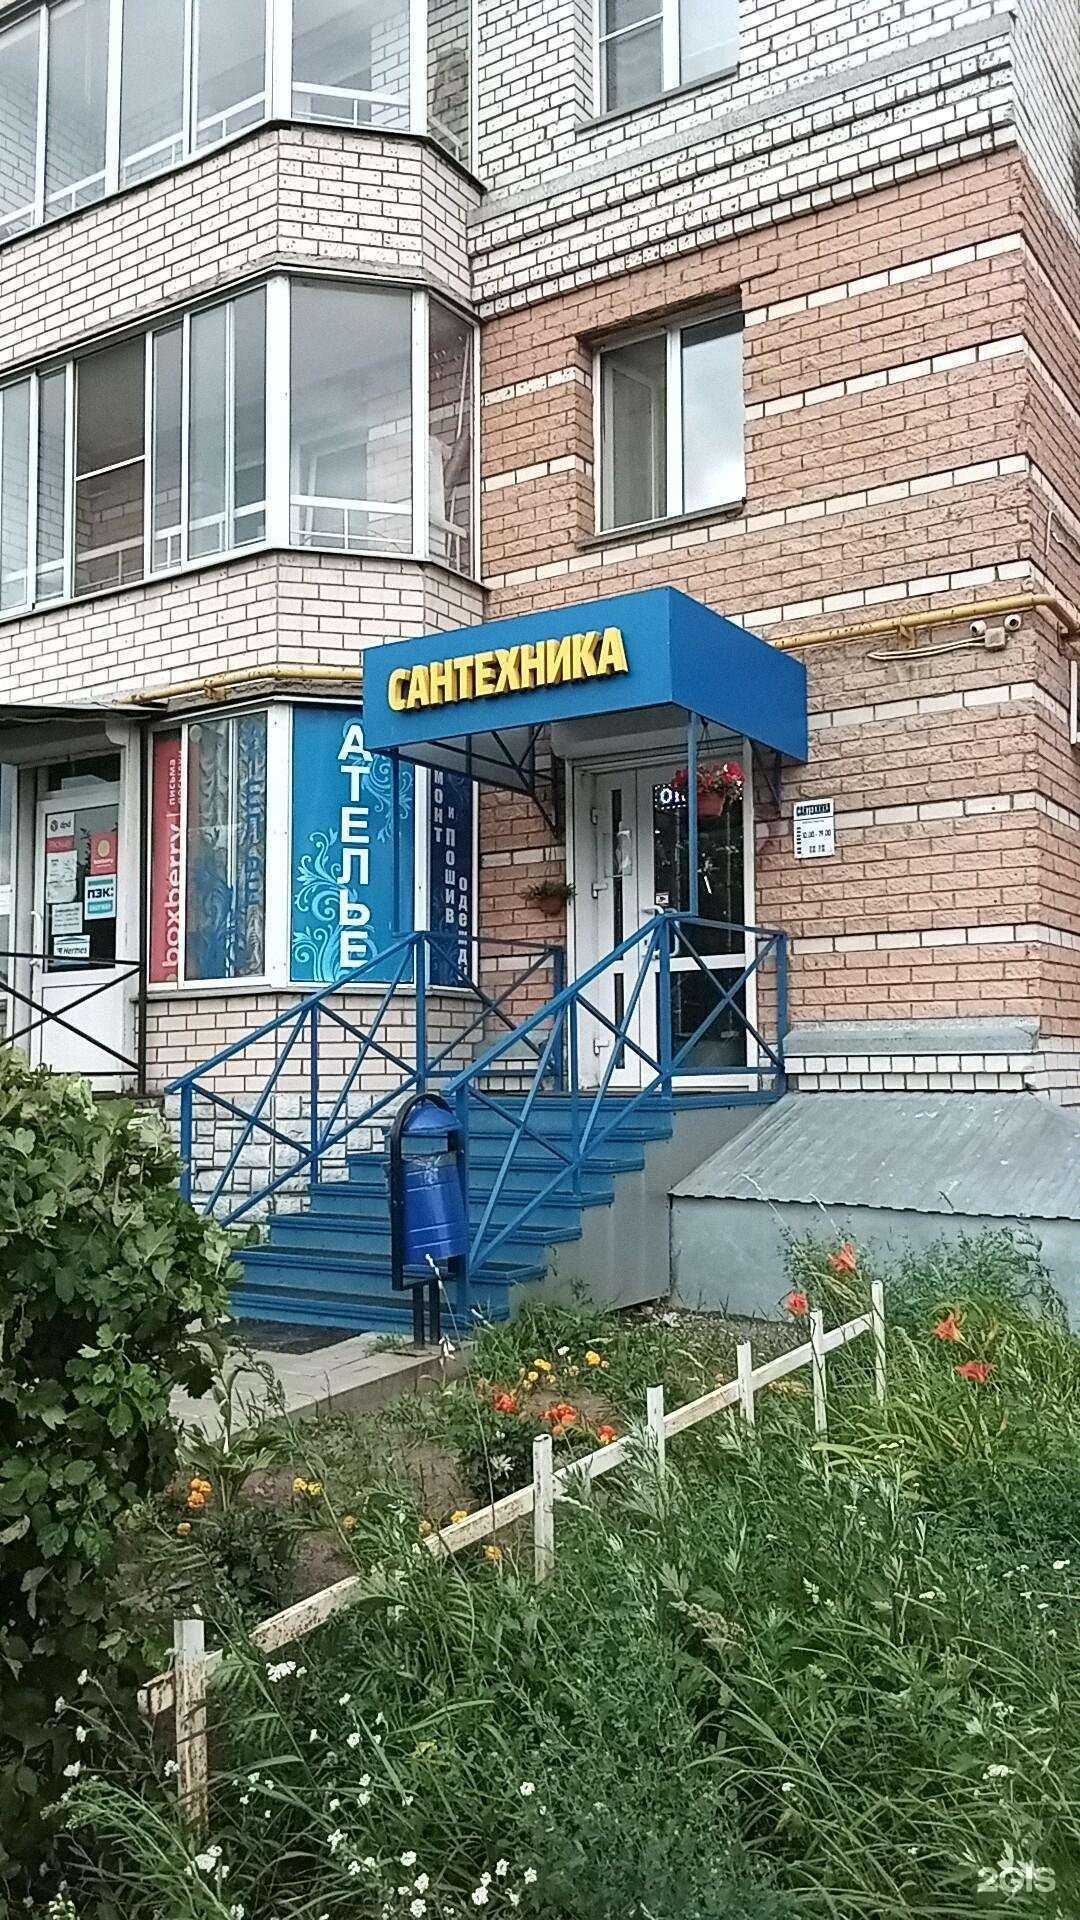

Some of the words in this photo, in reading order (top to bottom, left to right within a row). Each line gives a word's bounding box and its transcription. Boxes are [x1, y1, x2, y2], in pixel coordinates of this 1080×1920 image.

[388, 627, 629, 711] САНТЕХНИКА
[162, 823, 181, 967] boxberry
[337, 724, 373, 968] АТЕЛЬЕ
[63, 946, 88, 955] Hermes
